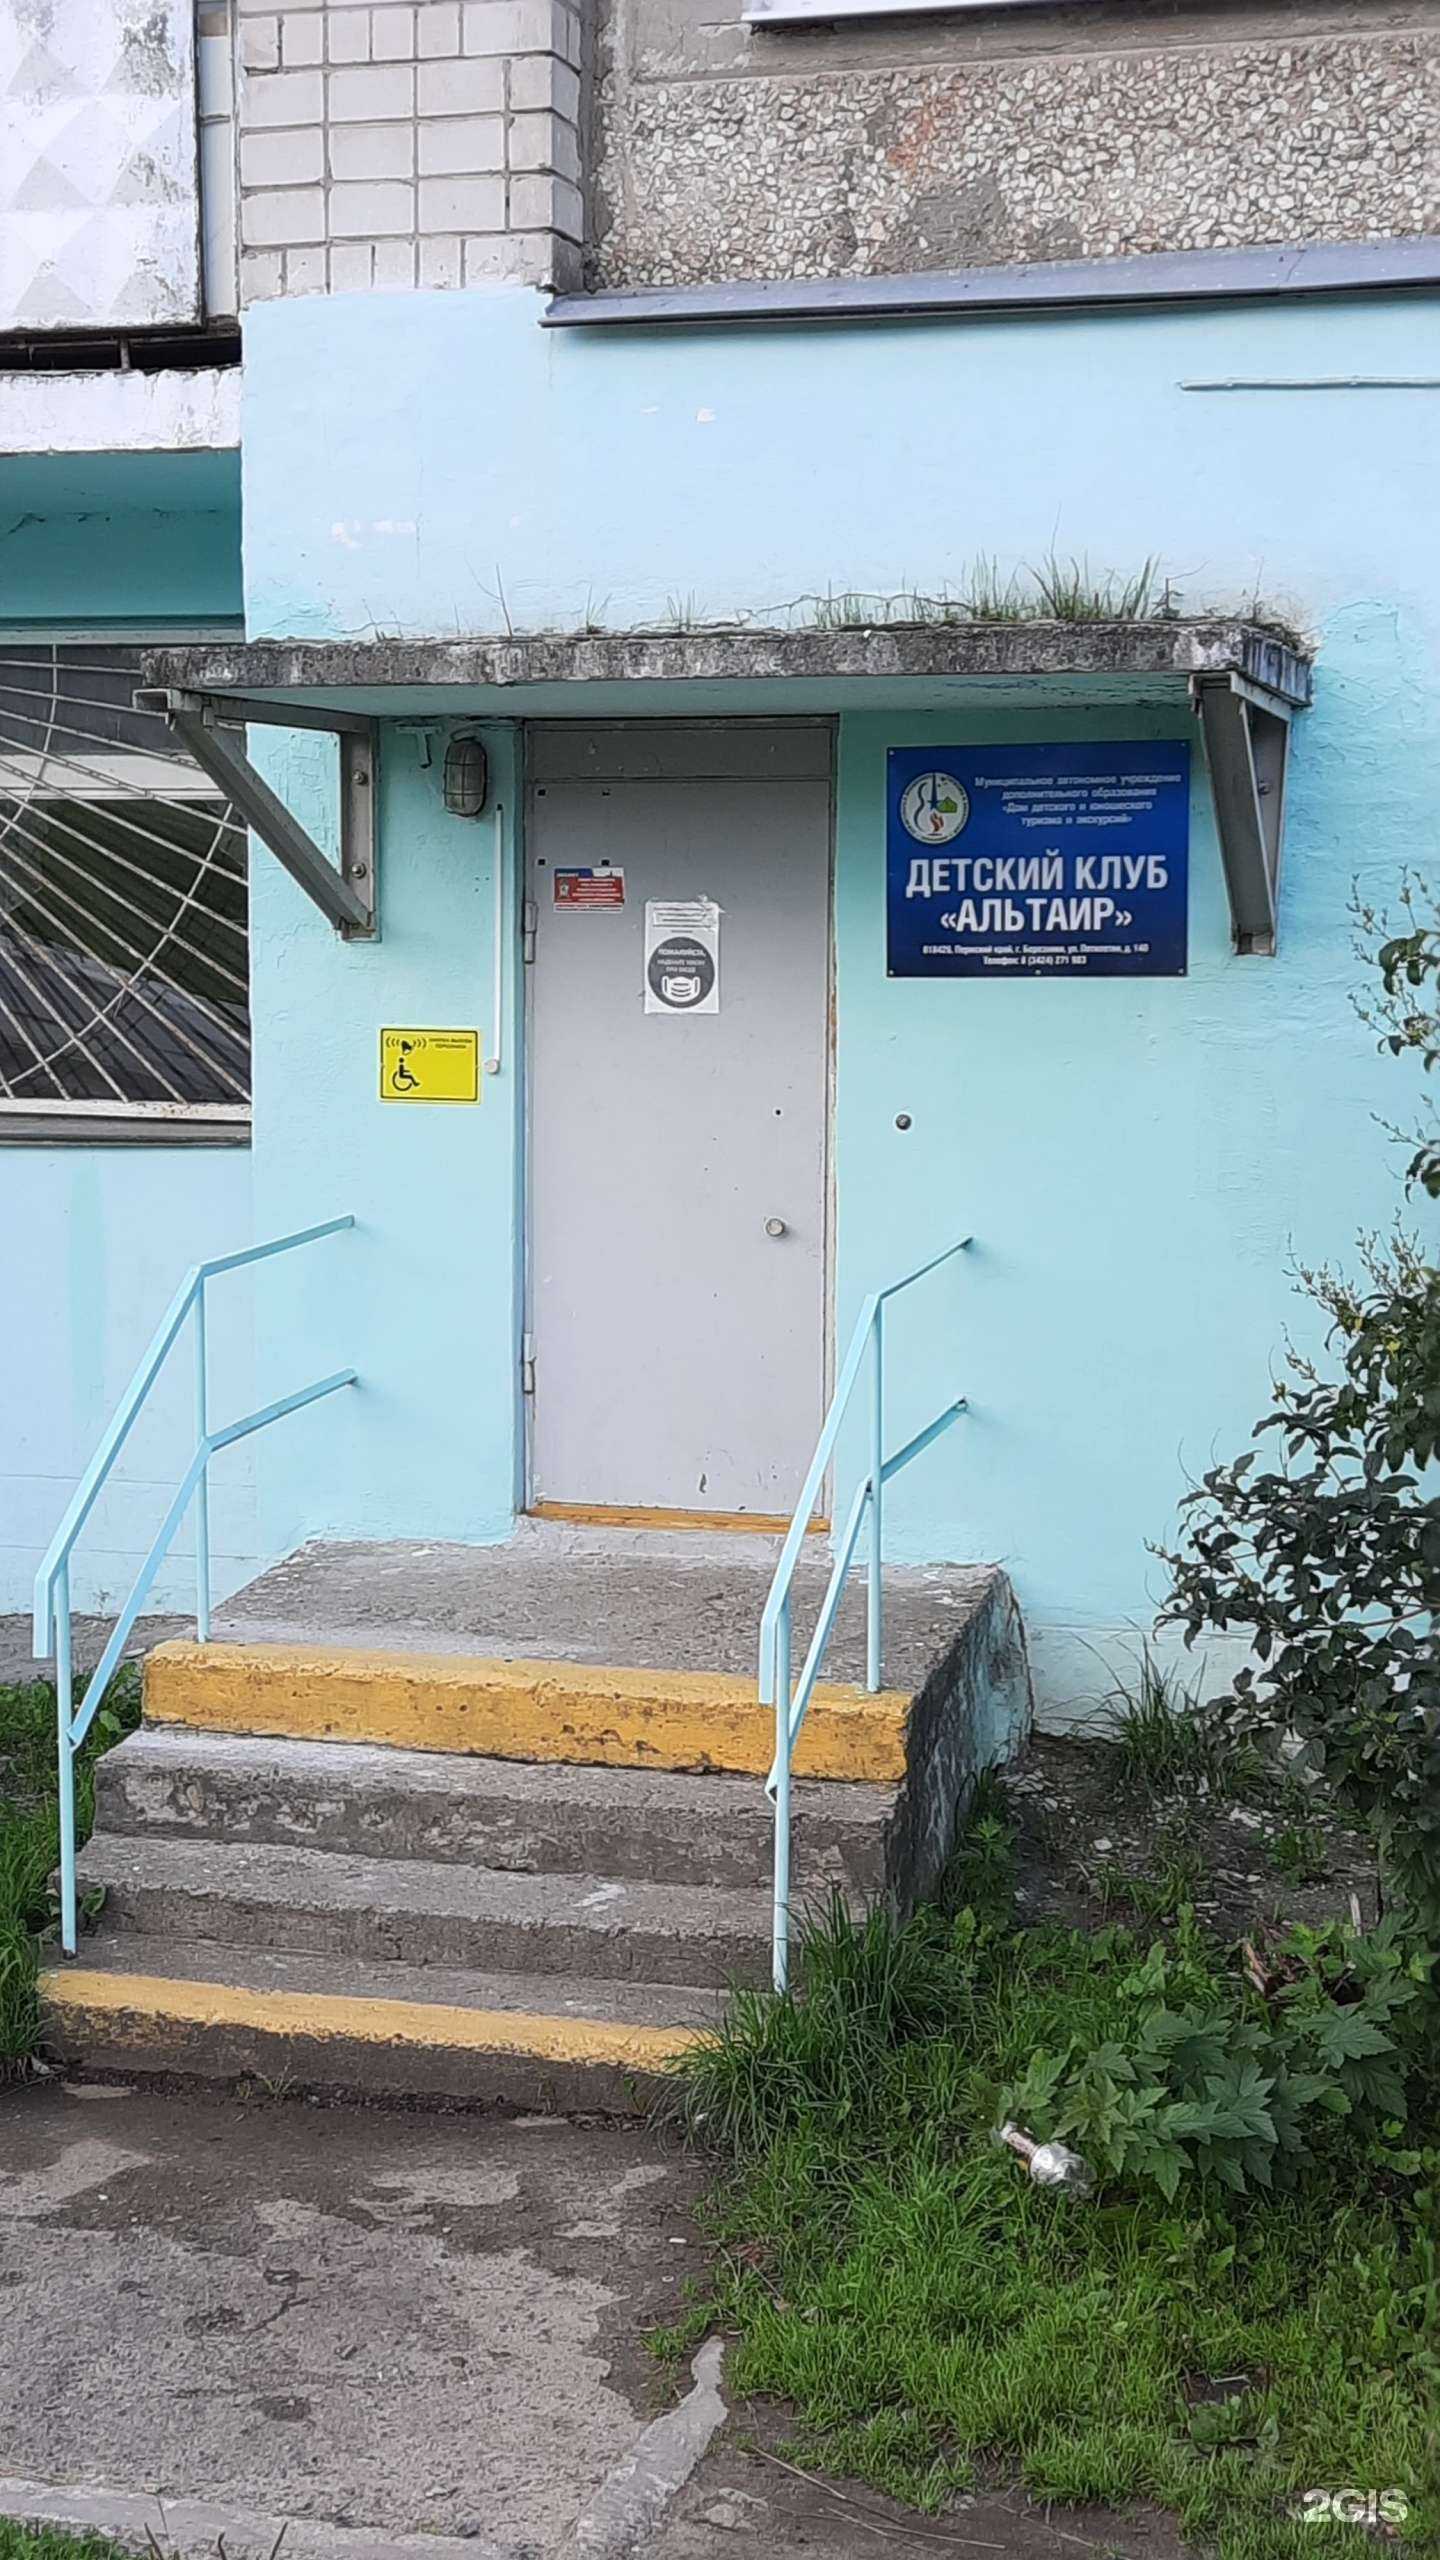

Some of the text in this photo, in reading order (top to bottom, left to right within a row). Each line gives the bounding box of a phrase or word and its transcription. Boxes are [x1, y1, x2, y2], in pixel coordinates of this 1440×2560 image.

[905, 849, 1168, 898] ДЕТСКИЙ КЛУБ
[940, 898, 1133, 932] «АЛЬТАИР»
